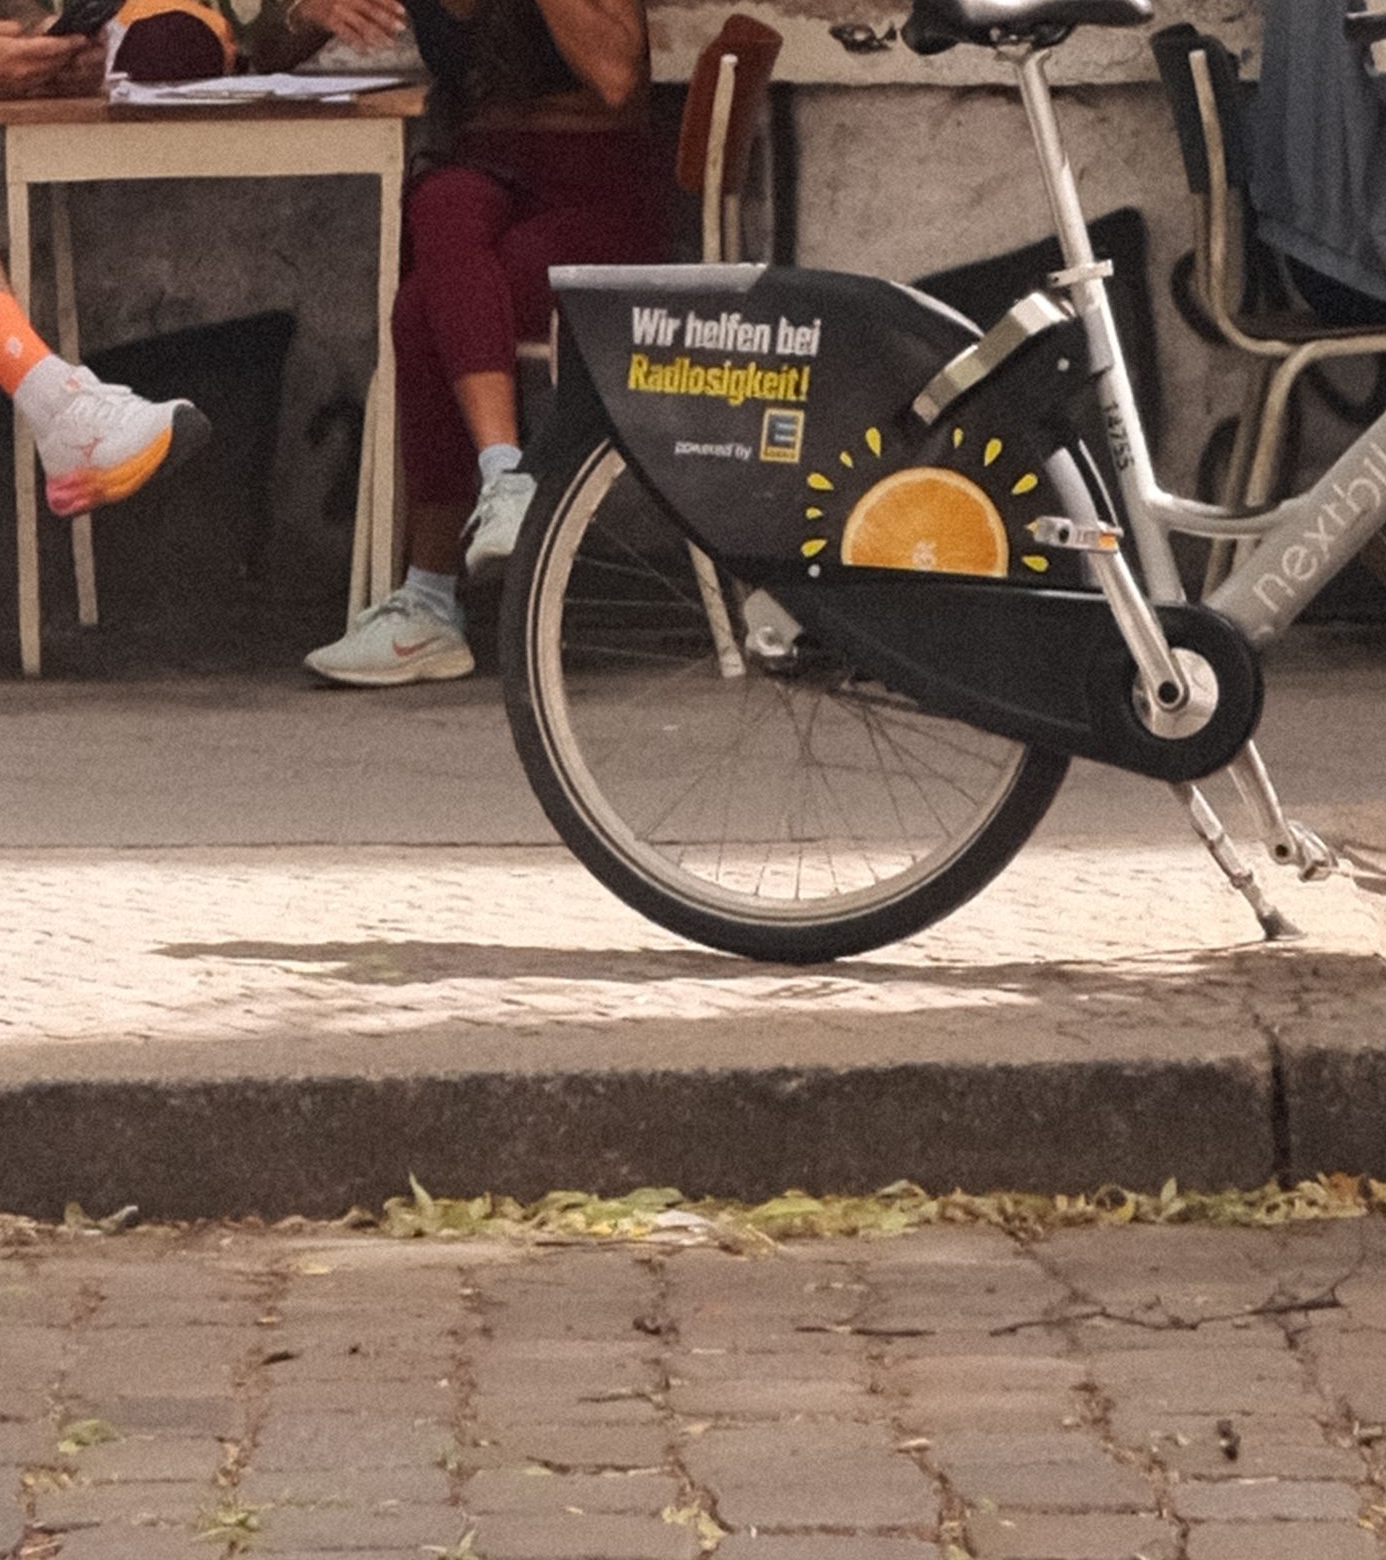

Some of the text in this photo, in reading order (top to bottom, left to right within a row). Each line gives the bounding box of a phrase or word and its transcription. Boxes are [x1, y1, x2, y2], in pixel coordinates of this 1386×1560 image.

[631, 306, 822, 357] Wir helfen bei
[627, 352, 810, 408] Radlosigkeit!
[674, 441, 733, 459] powered
[734, 443, 753, 461] by
